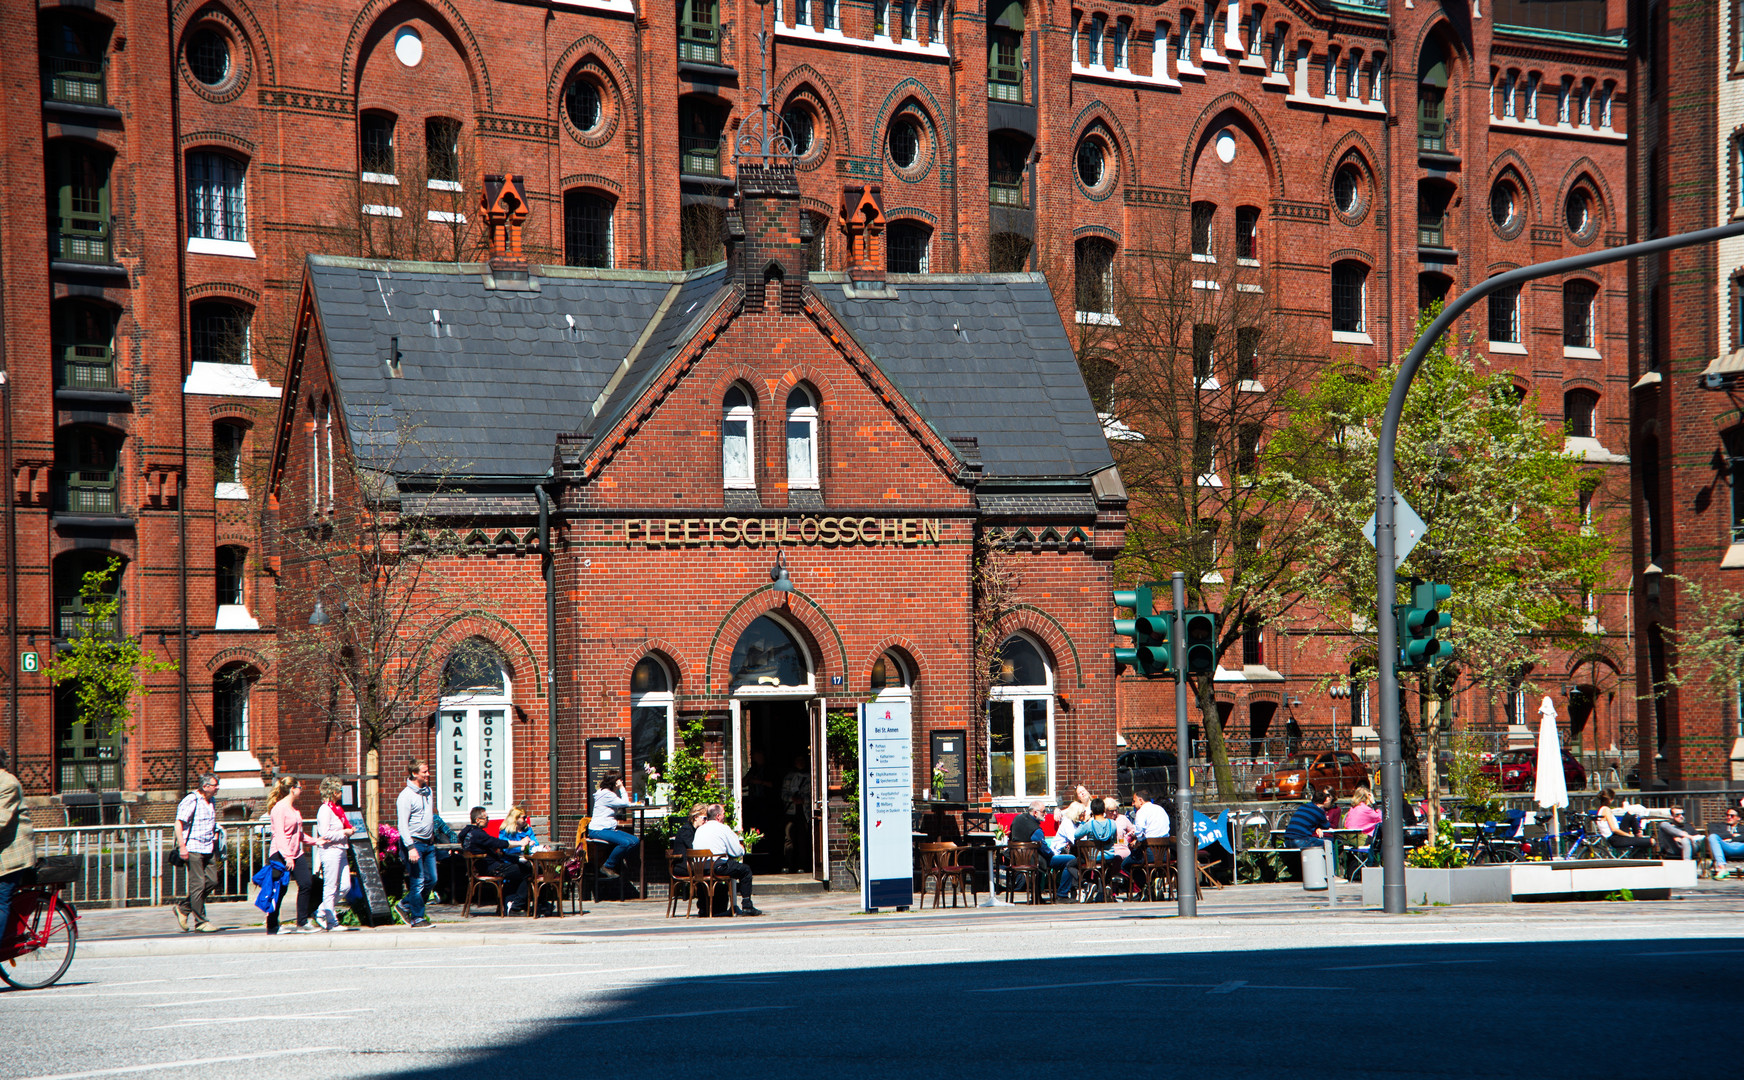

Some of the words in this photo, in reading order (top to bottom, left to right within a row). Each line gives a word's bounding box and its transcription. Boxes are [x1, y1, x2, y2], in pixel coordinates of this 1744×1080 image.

[625, 513, 940, 543] FLEETSCHLÖSSCHEN
[25, 654, 35, 669] 6
[833, 676, 842, 685] 17
[452, 712, 463, 807] GALLERY
[483, 716, 493, 801] GOTTCHEN
